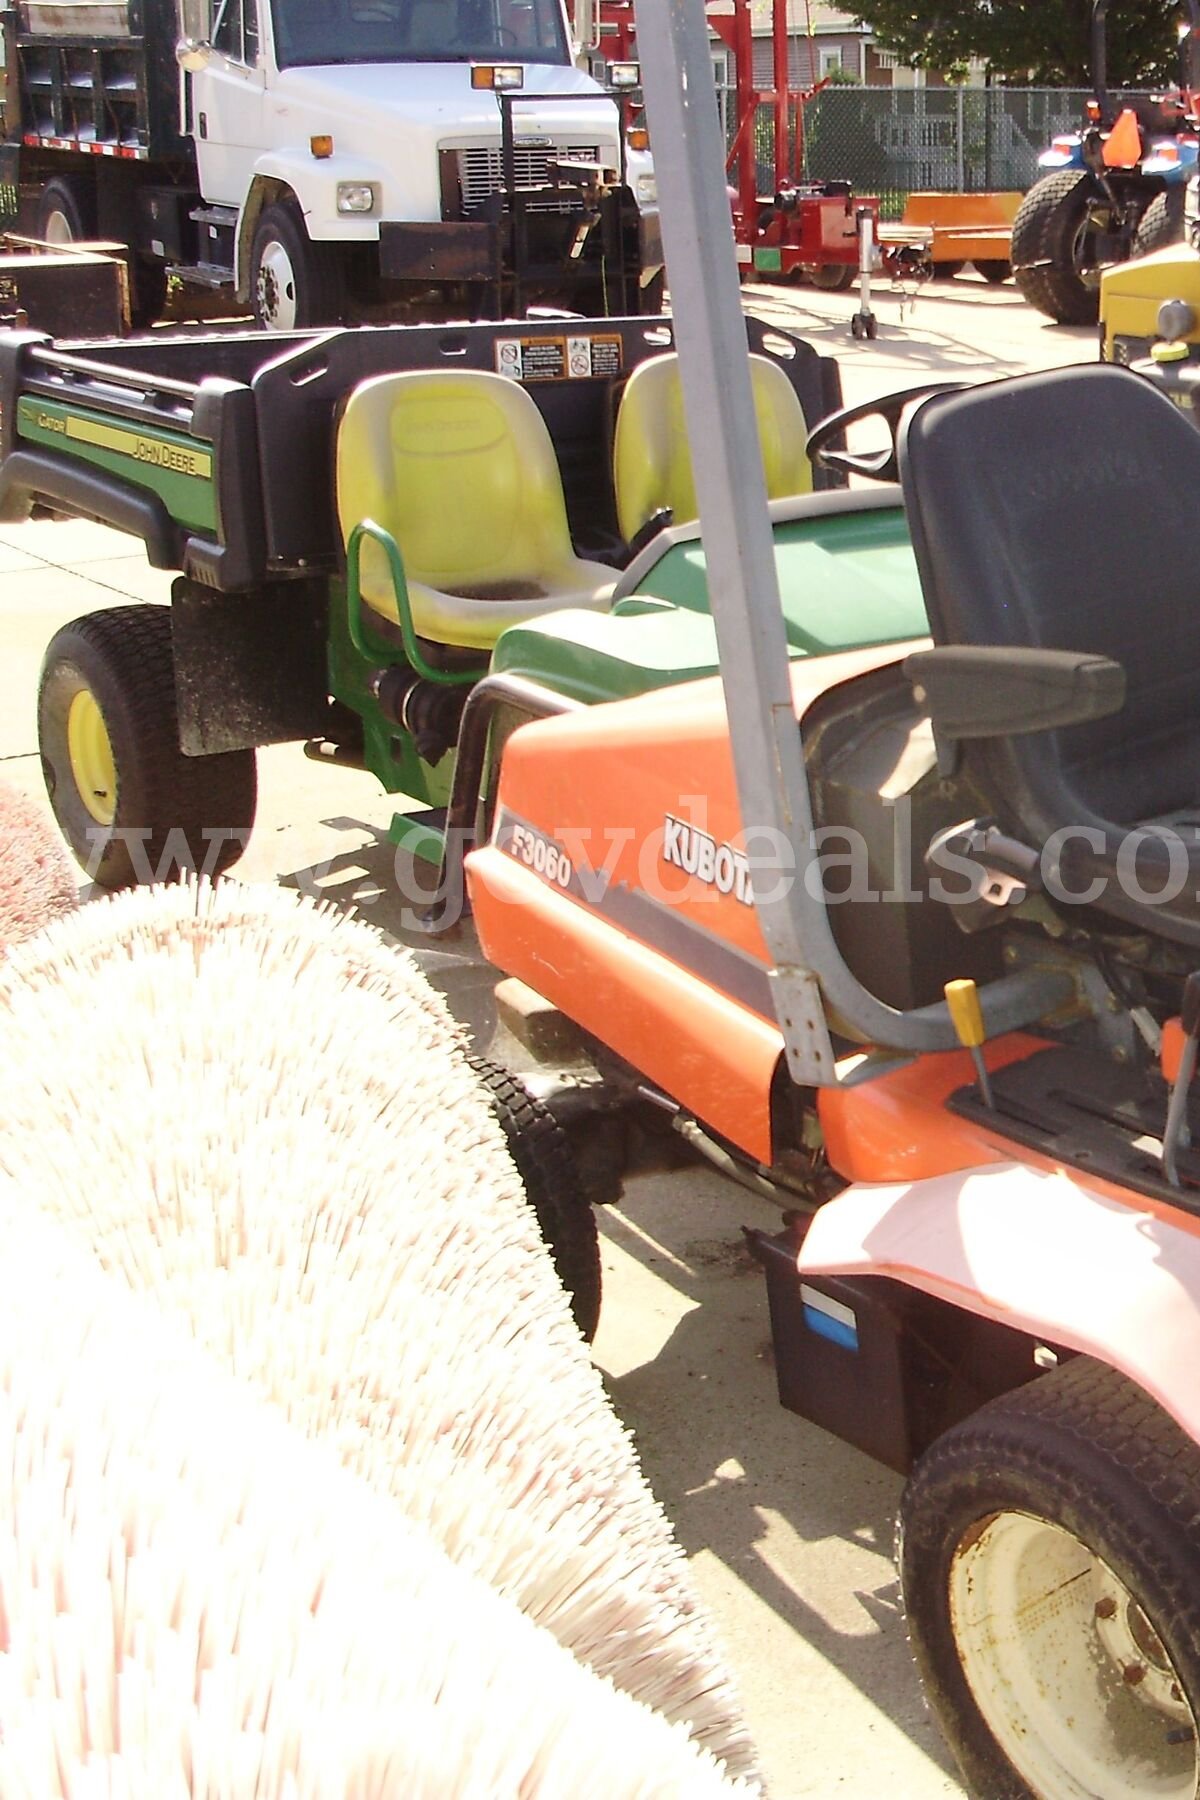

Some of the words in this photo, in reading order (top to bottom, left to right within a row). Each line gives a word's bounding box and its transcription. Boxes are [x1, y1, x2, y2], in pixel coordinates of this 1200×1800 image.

[132, 438, 161, 464] JOHN
[162, 446, 196, 475] DEERE
[511, 824, 571, 888] F3060
